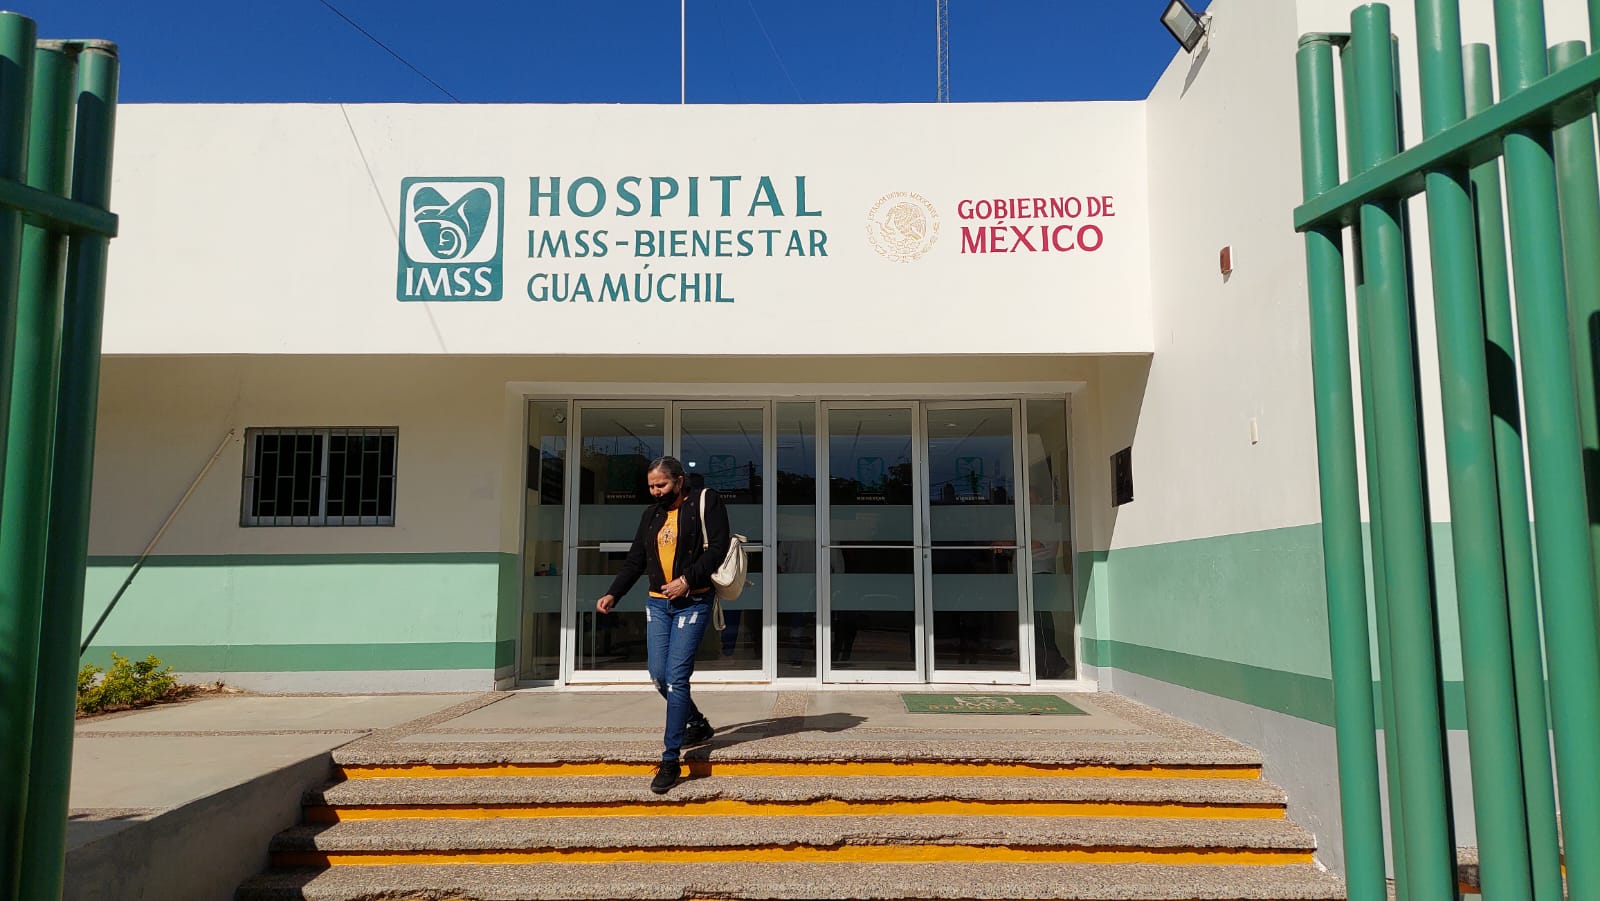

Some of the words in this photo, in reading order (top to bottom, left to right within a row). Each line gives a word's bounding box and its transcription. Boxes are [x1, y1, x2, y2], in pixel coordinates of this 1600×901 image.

[529, 175, 823, 218] HOSPITAL
[957, 196, 1082, 220] GOBIERNO
[1087, 195, 1116, 218] DE
[528, 229, 829, 258] IMSS-BIENESTAR
[960, 221, 1104, 254] MÉXICO
[405, 266, 492, 297] IMSS
[526, 263, 735, 304] GUAMÚCHIL
